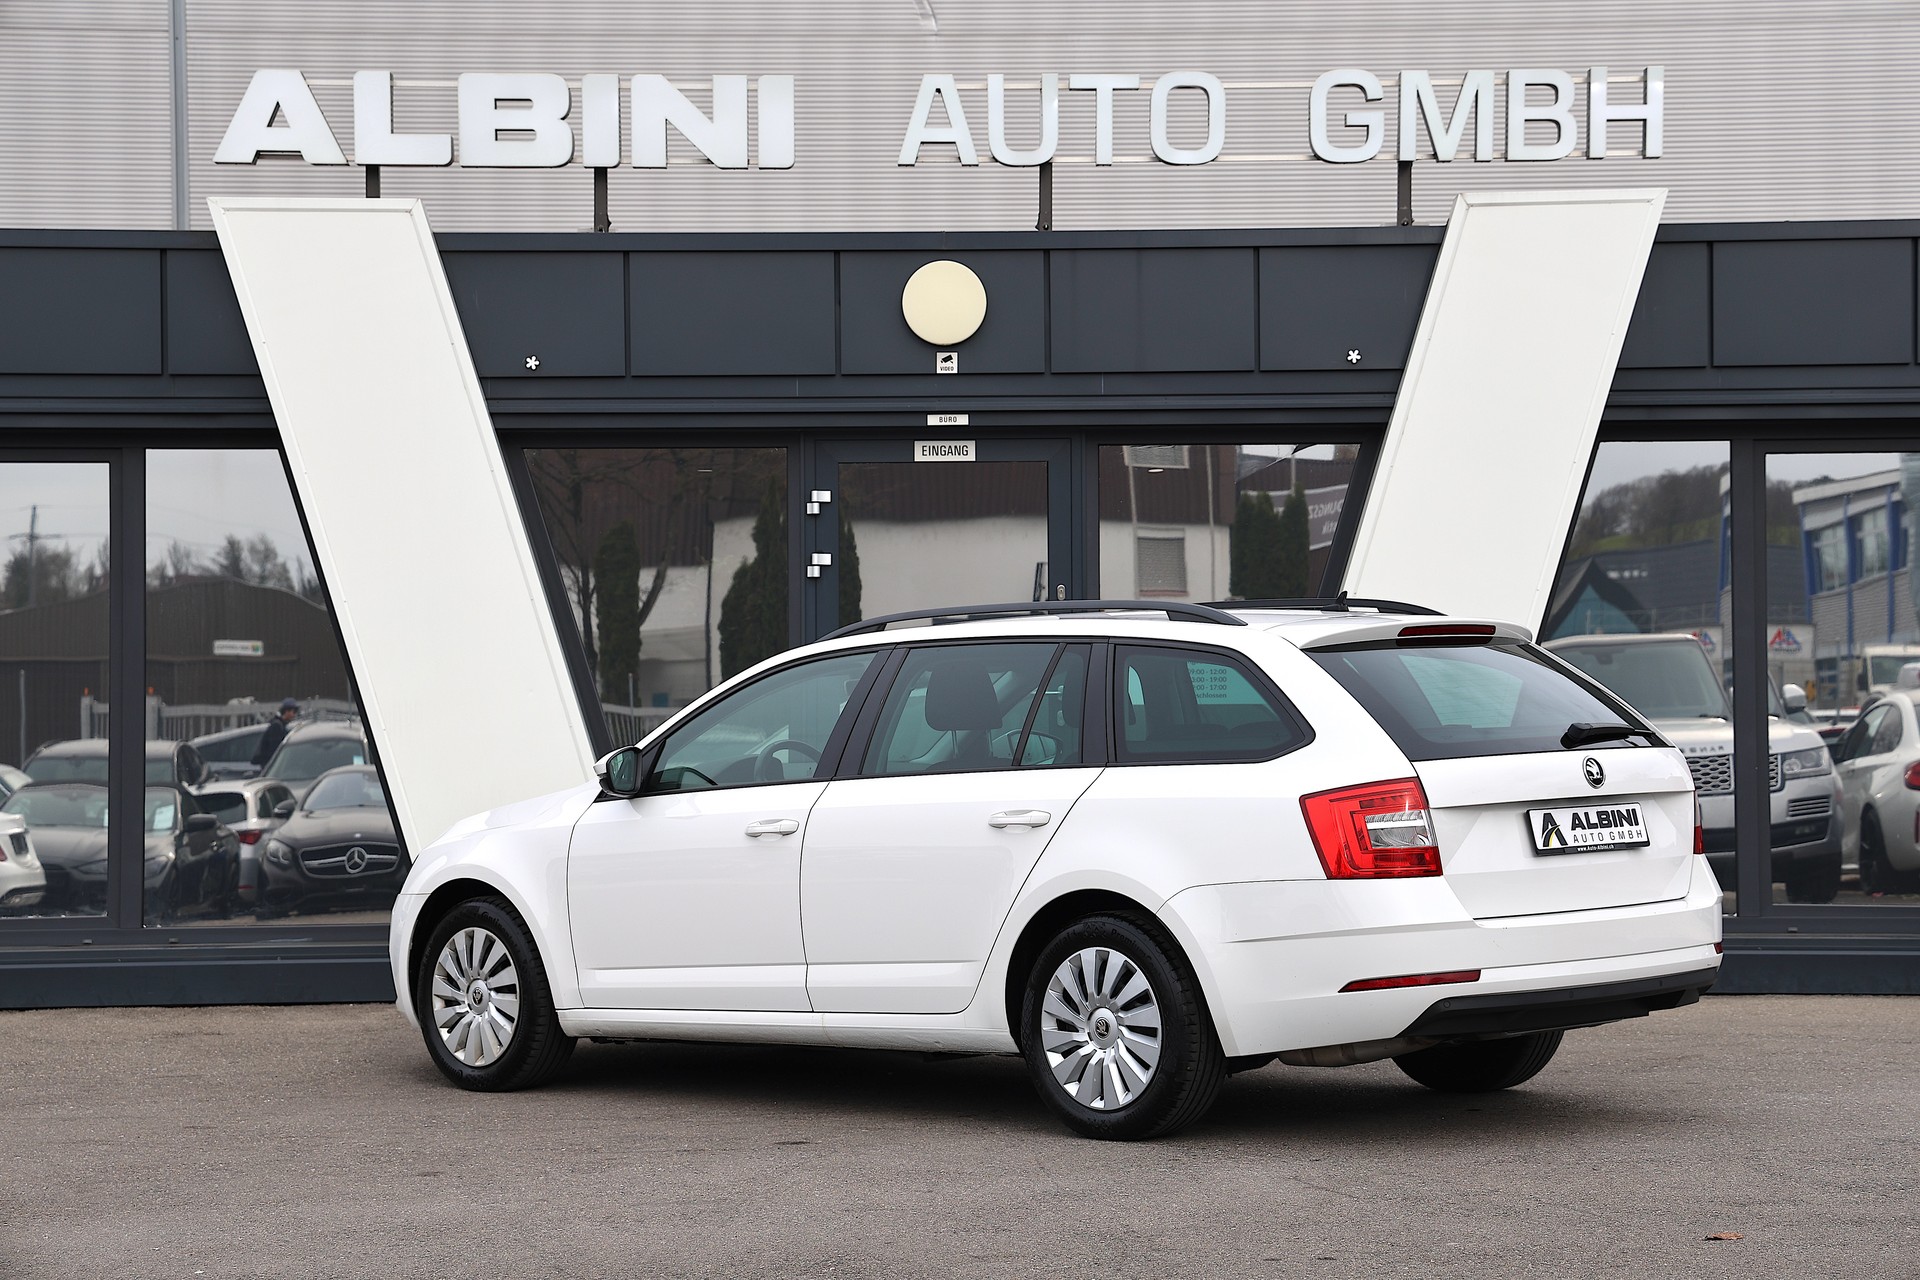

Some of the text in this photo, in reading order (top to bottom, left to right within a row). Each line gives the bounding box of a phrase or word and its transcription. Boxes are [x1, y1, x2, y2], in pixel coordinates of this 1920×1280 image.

[213, 66, 1666, 170] ALBINI AUTO GMBH
[938, 415, 958, 423] BÜRO
[921, 445, 969, 457] EINGANG
[1570, 808, 1640, 831] ALBINI
[1573, 829, 1643, 844] AUTO GMBH
